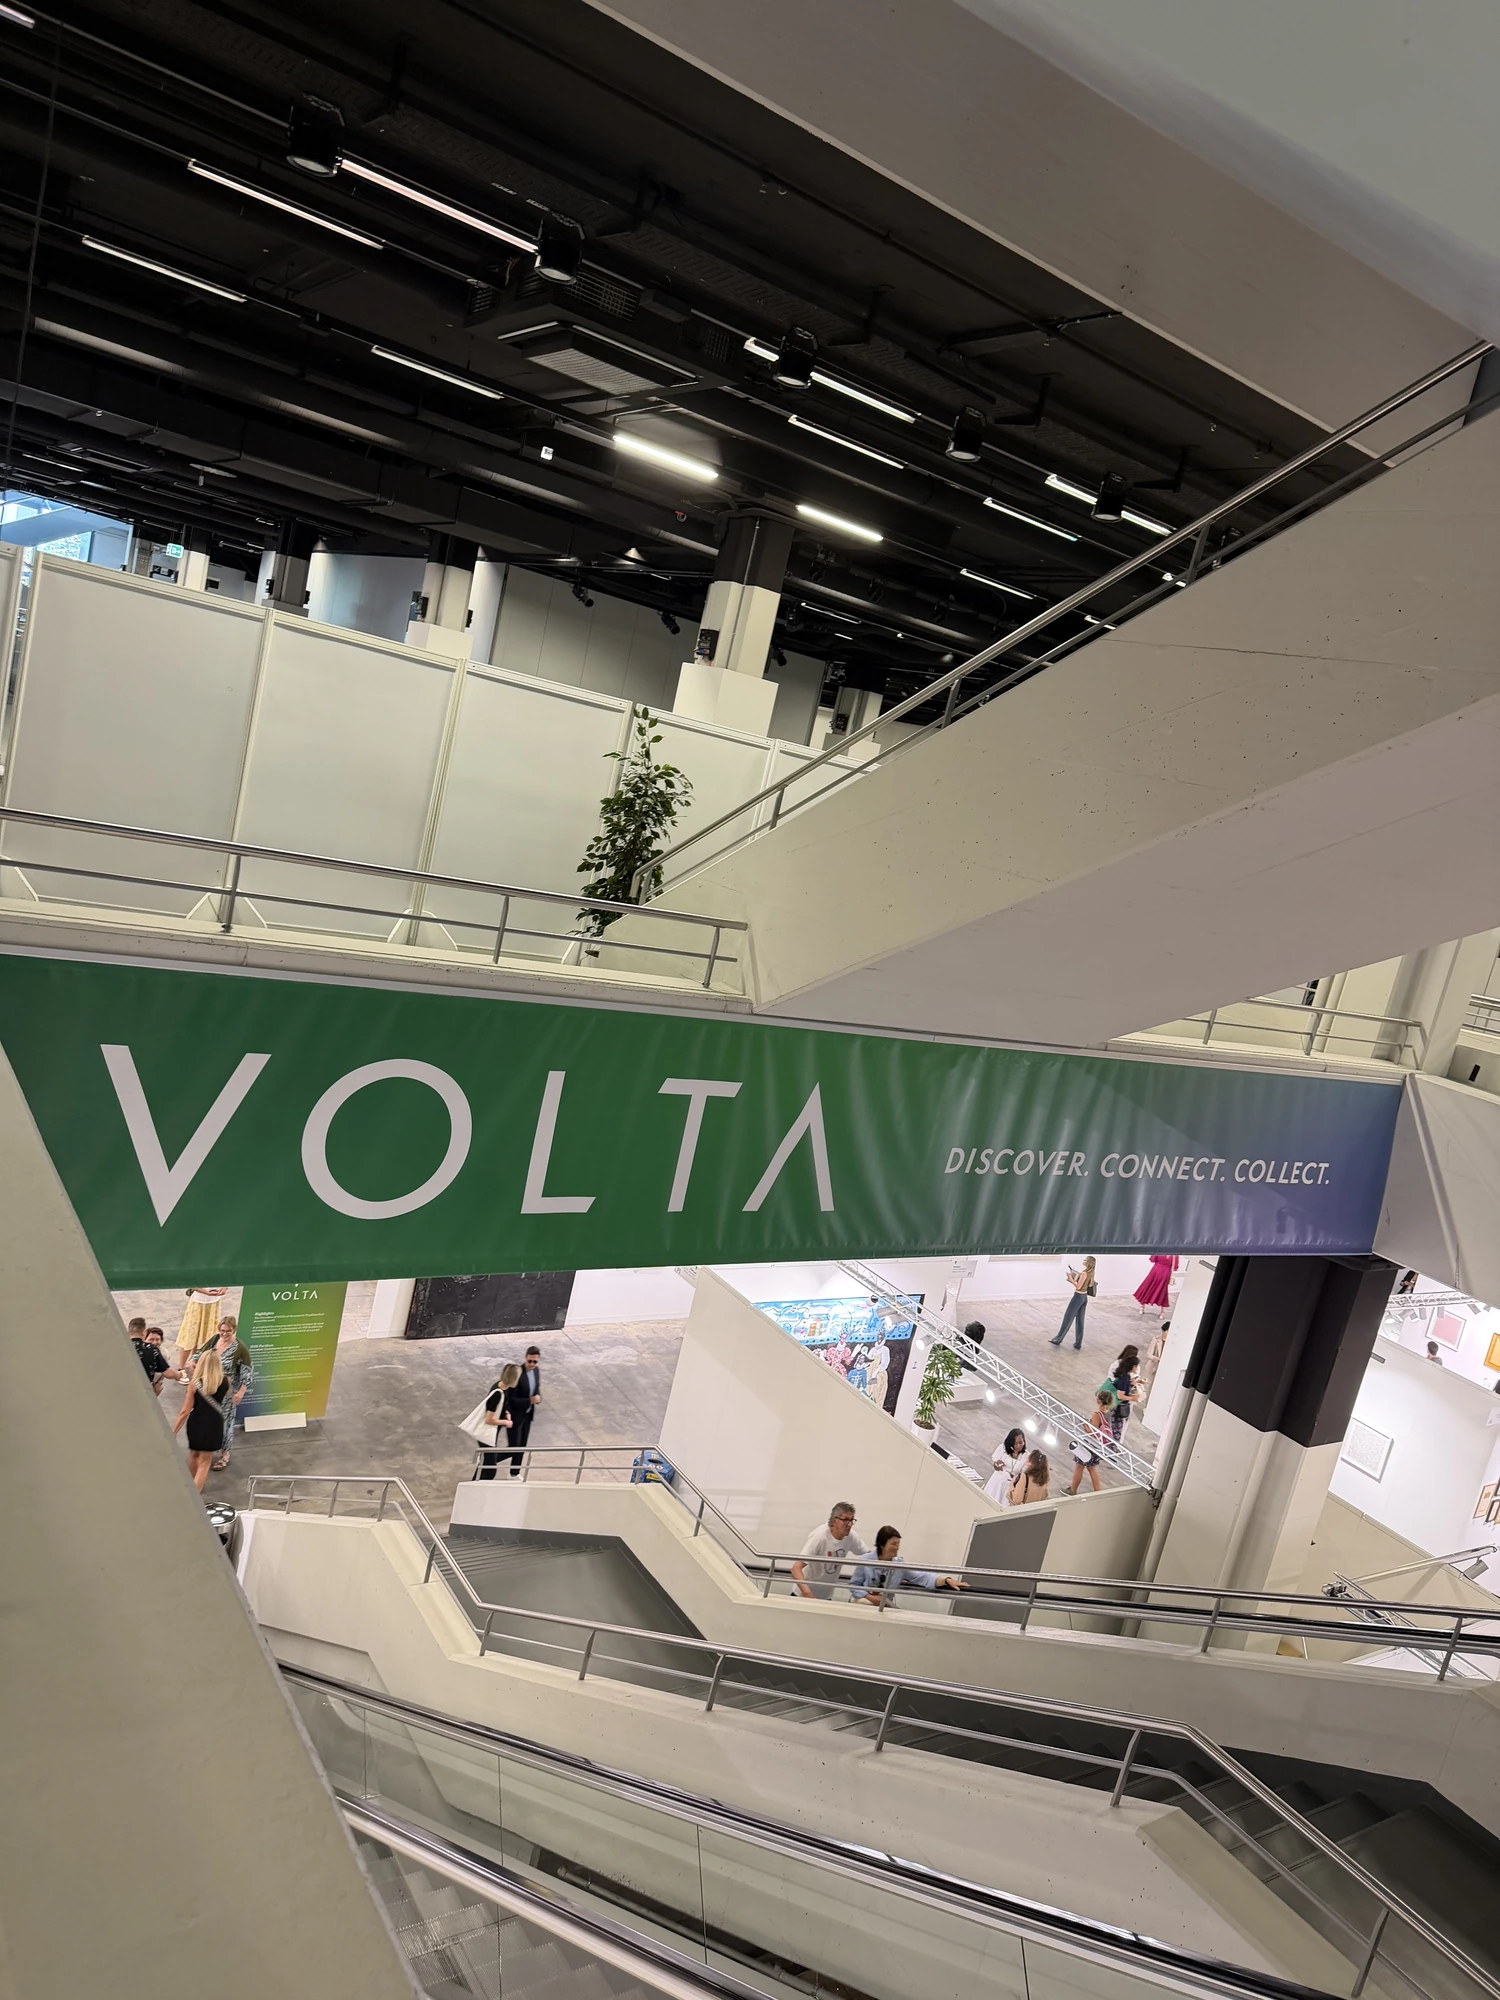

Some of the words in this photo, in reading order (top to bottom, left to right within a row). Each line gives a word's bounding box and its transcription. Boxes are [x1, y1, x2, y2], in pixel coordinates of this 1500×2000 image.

[100, 1044, 835, 1227] VOLTA
[944, 1147, 1089, 1177] DISCOVER.
[1100, 1153, 1225, 1182] CONNECT.
[1234, 1158, 1331, 1185] COLLECT.
[271, 1290, 318, 1301] VOLTA
